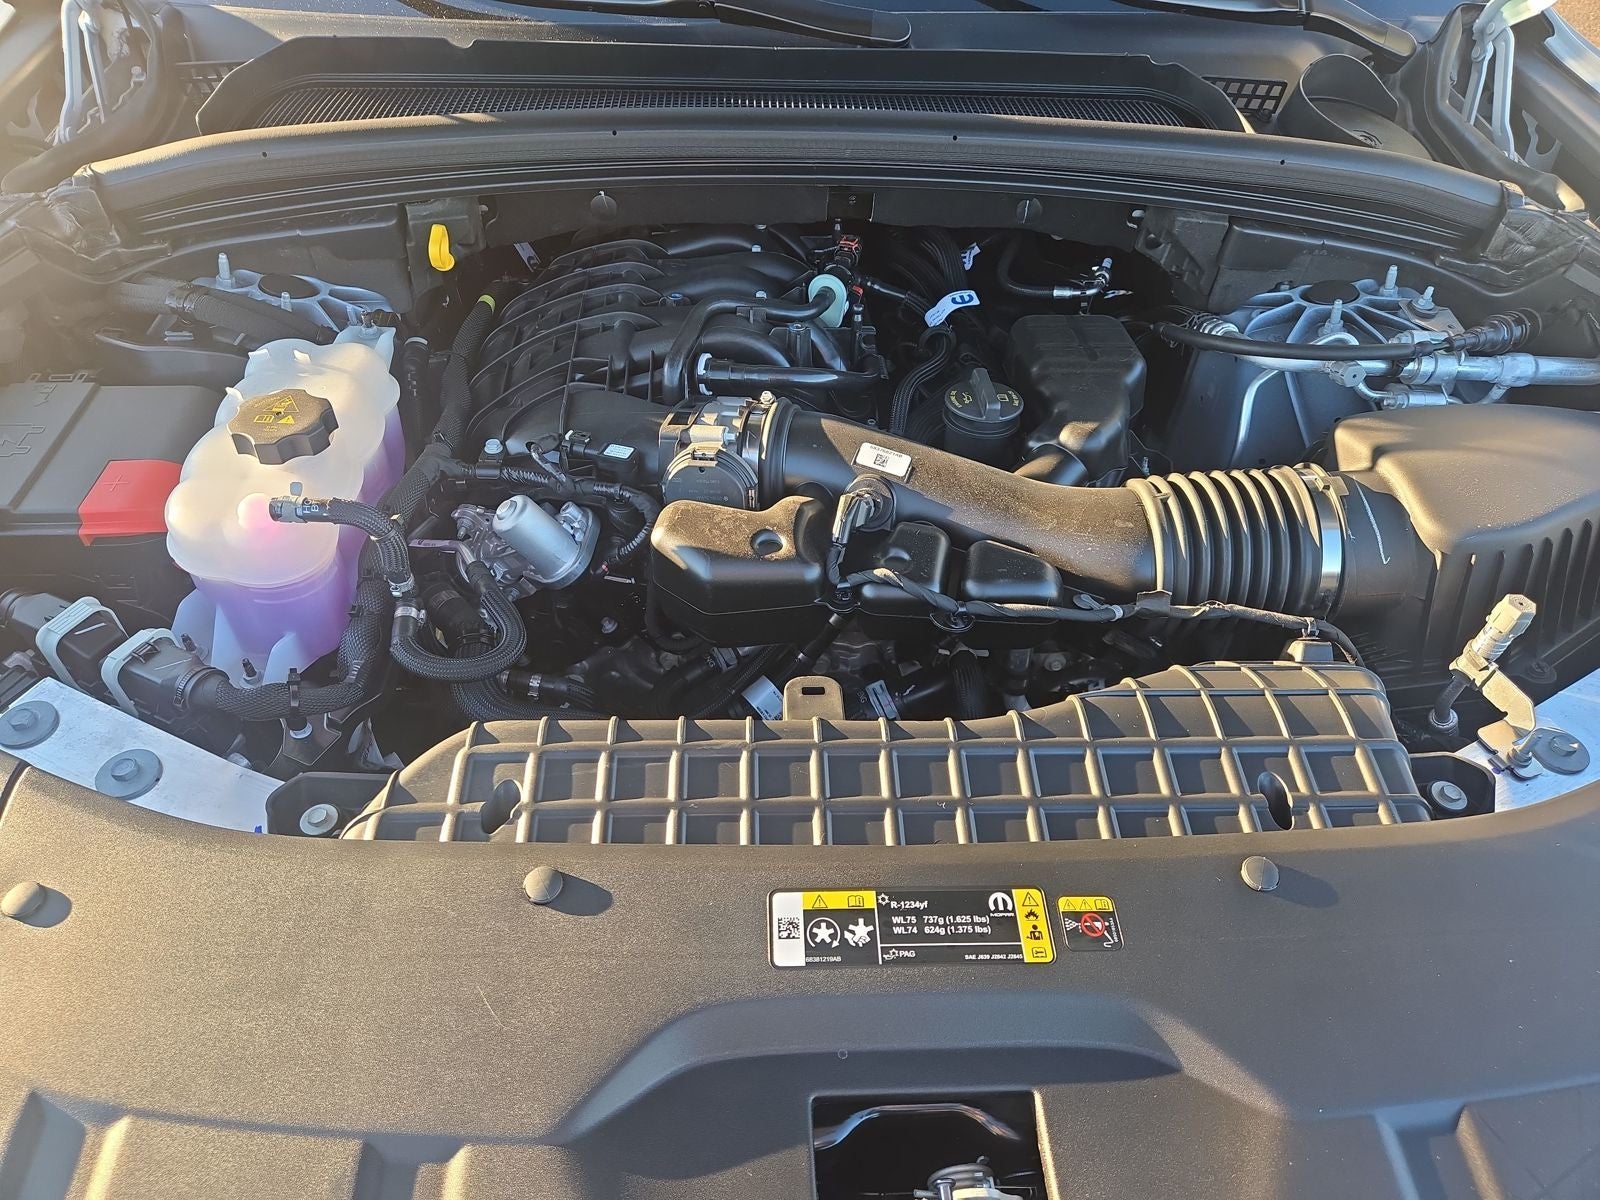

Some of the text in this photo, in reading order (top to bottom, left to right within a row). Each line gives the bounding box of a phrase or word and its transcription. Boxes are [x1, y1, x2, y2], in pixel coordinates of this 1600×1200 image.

[890, 901, 928, 909] R-1234yf
[892, 915, 990, 925] WL75 737g (1.625 lbs)
[893, 925, 992, 935] WL74 624g (1.375 lbs)
